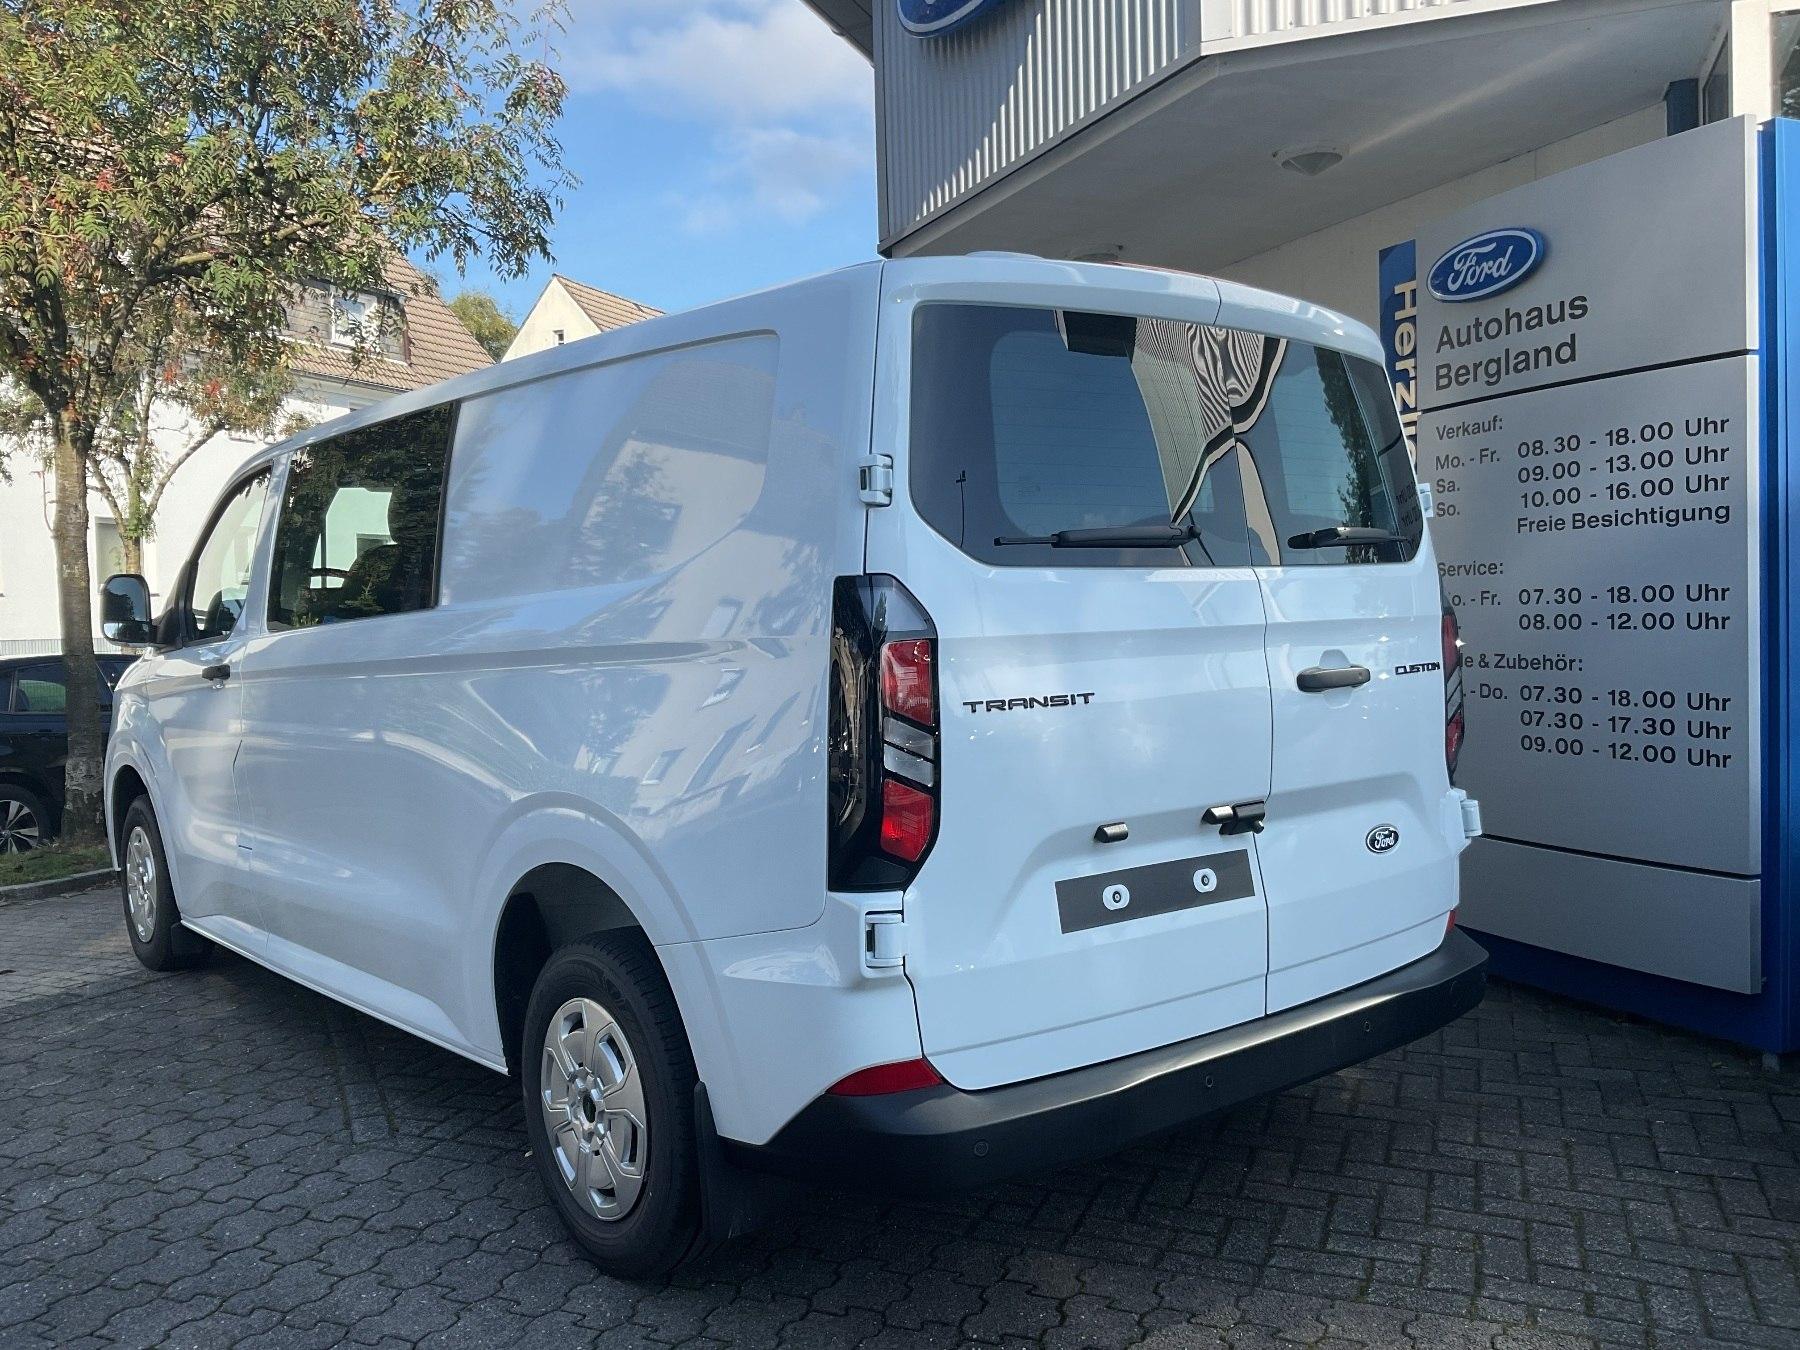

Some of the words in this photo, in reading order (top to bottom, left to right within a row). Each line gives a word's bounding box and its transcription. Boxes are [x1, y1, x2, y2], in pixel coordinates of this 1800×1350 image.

[1447, 242, 1514, 292] Ford
[1435, 295, 1588, 354] Autohaus
[1436, 334, 1576, 390] Bergland
[1436, 415, 1502, 440] Verkauf:
[1436, 454, 1464, 470] Mo.
[1480, 448, 1499, 464] Fr.
[1518, 435, 1580, 458] 08.30
[1605, 422, 1673, 446] 18.00
[1686, 417, 1729, 436] Uhr
[1437, 479, 1460, 493] Sa.
[1518, 461, 1580, 483] 09.00
[1606, 450, 1673, 473] 13.00
[1686, 446, 1729, 465] Uhr
[1437, 502, 1460, 517] So.
[1521, 487, 1580, 508] 10.00
[1606, 478, 1673, 500] 16.00
[1686, 474, 1729, 493] Uhr
[1518, 516, 1565, 533] Freie
[1572, 504, 1730, 529] Besichtigung
[1438, 560, 1503, 578] Service:
[1481, 591, 1500, 605] Fr.
[1519, 588, 1581, 605] 07.30
[1607, 585, 1674, 603] 18.00
[1686, 584, 1730, 602] Uhr
[1519, 614, 1582, 630] 08.00
[1607, 612, 1674, 630] 12.00
[1687, 612, 1730, 630] Uhr
[1494, 654, 1582, 671] Zubehör:
[963, 693, 1095, 713] TRANSIT
[1480, 683, 1507, 699] Do.
[1520, 685, 1582, 704] 07.30
[1608, 690, 1675, 708] 18.00
[1687, 693, 1731, 711] Uhr
[1521, 710, 1583, 730] 07.30
[1608, 716, 1675, 736] 17.30
[1688, 721, 1731, 739] Uhr
[1521, 735, 1583, 755] 09.00
[1608, 743, 1676, 763] 12.00
[1688, 748, 1731, 768] Uhr
[1374, 830, 1394, 848] Ford
